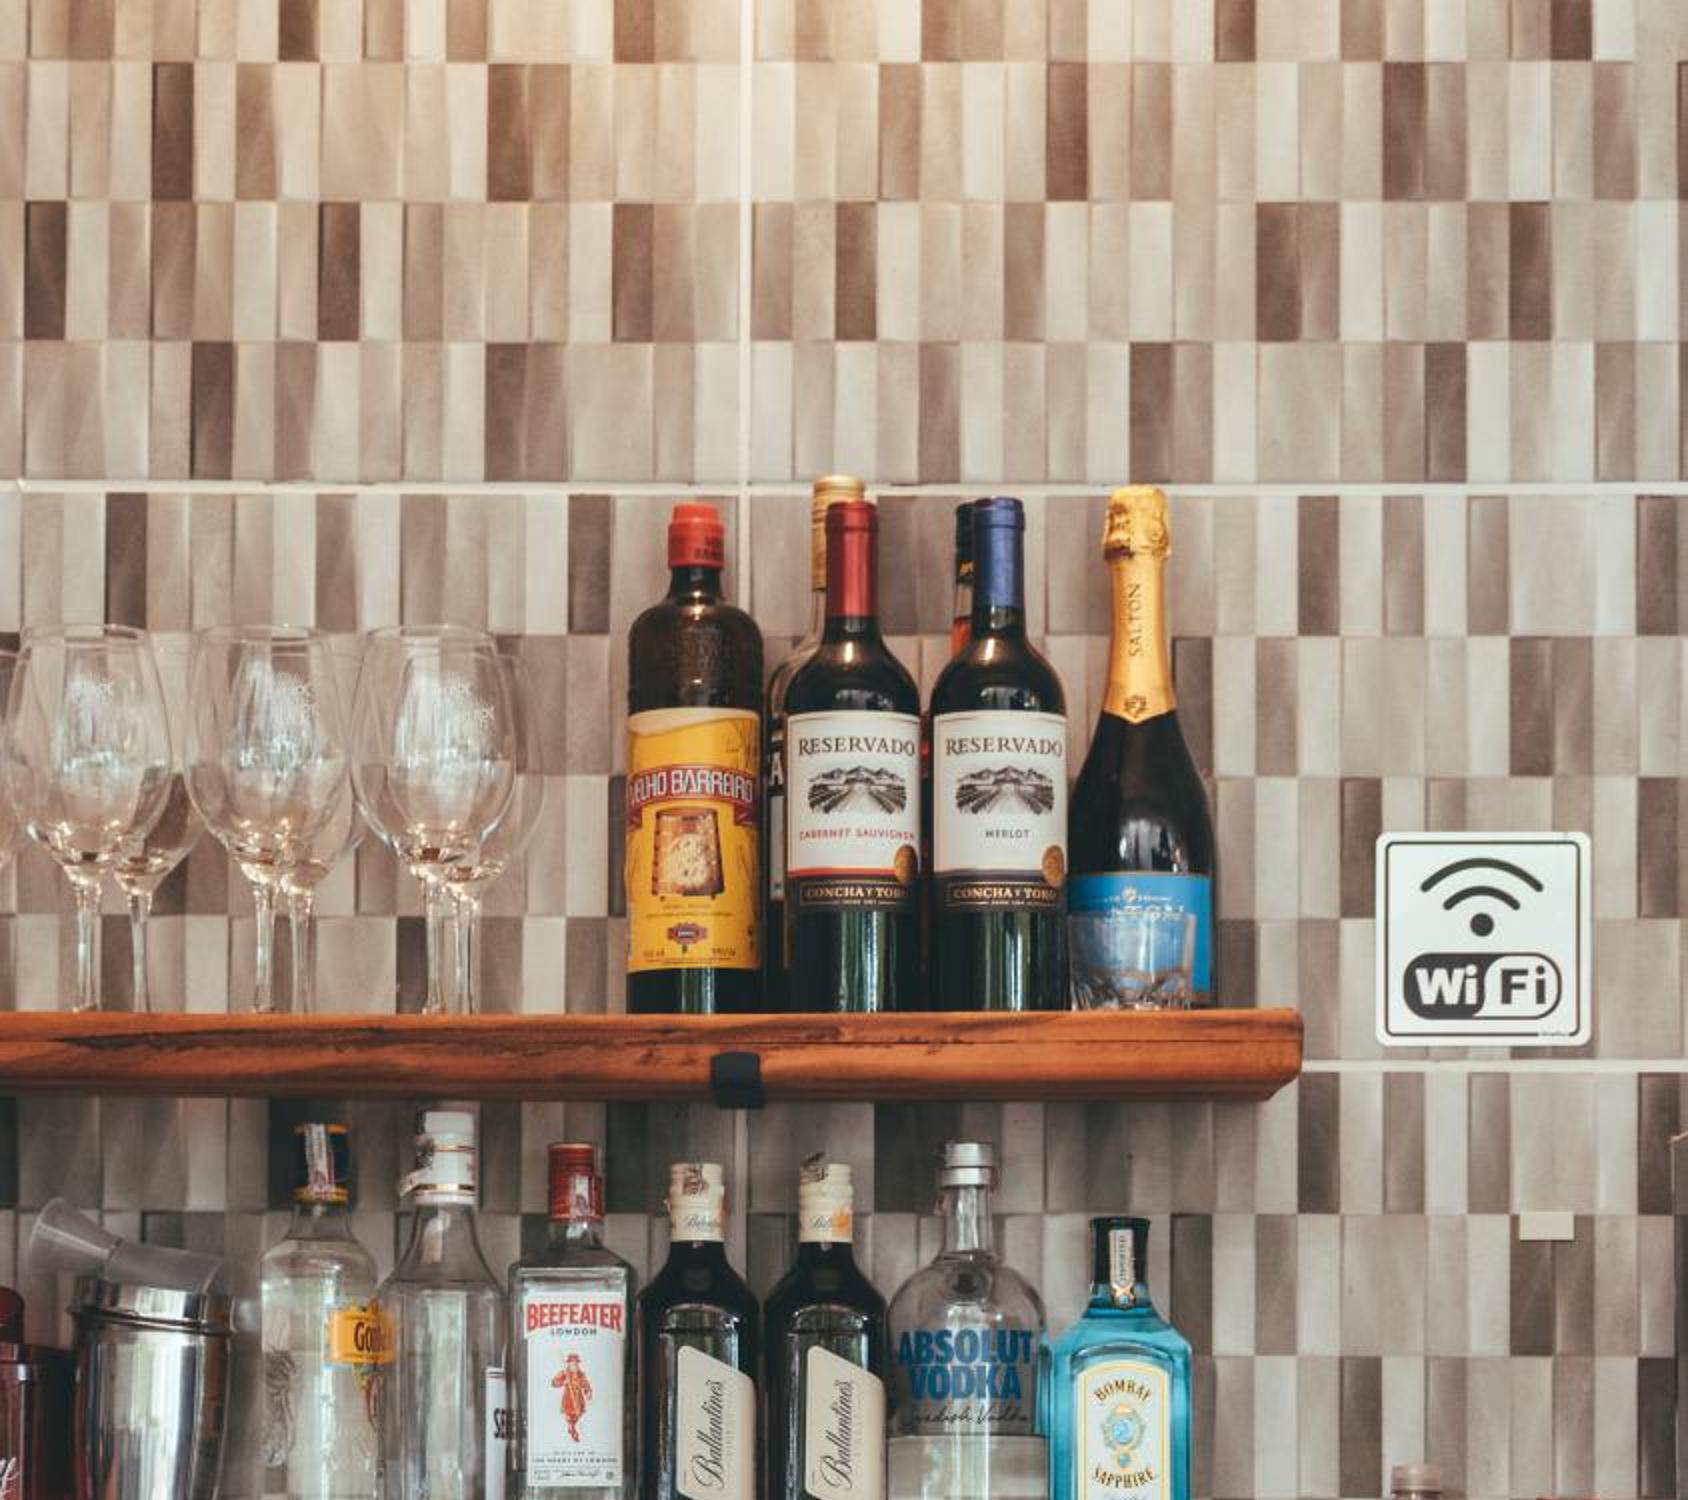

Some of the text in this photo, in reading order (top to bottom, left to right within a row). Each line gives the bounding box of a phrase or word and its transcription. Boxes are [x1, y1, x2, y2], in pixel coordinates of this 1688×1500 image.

[1128, 582, 1142, 658] SALTON
[798, 735, 916, 757] RESERVADO
[945, 736, 1063, 757] RESERVADO
[671, 769, 753, 802] BARREIRO
[985, 830, 1030, 839] MERLOT
[527, 1303, 623, 1333] BEEFEATER
[551, 1327, 598, 1337] LONDON
[899, 1328, 1032, 1365] ABSOLUT
[910, 1364, 1022, 1400] VODKA
[1094, 1380, 1152, 1402] BOMBAY
[1094, 1465, 1153, 1488] SAPPHIRE
